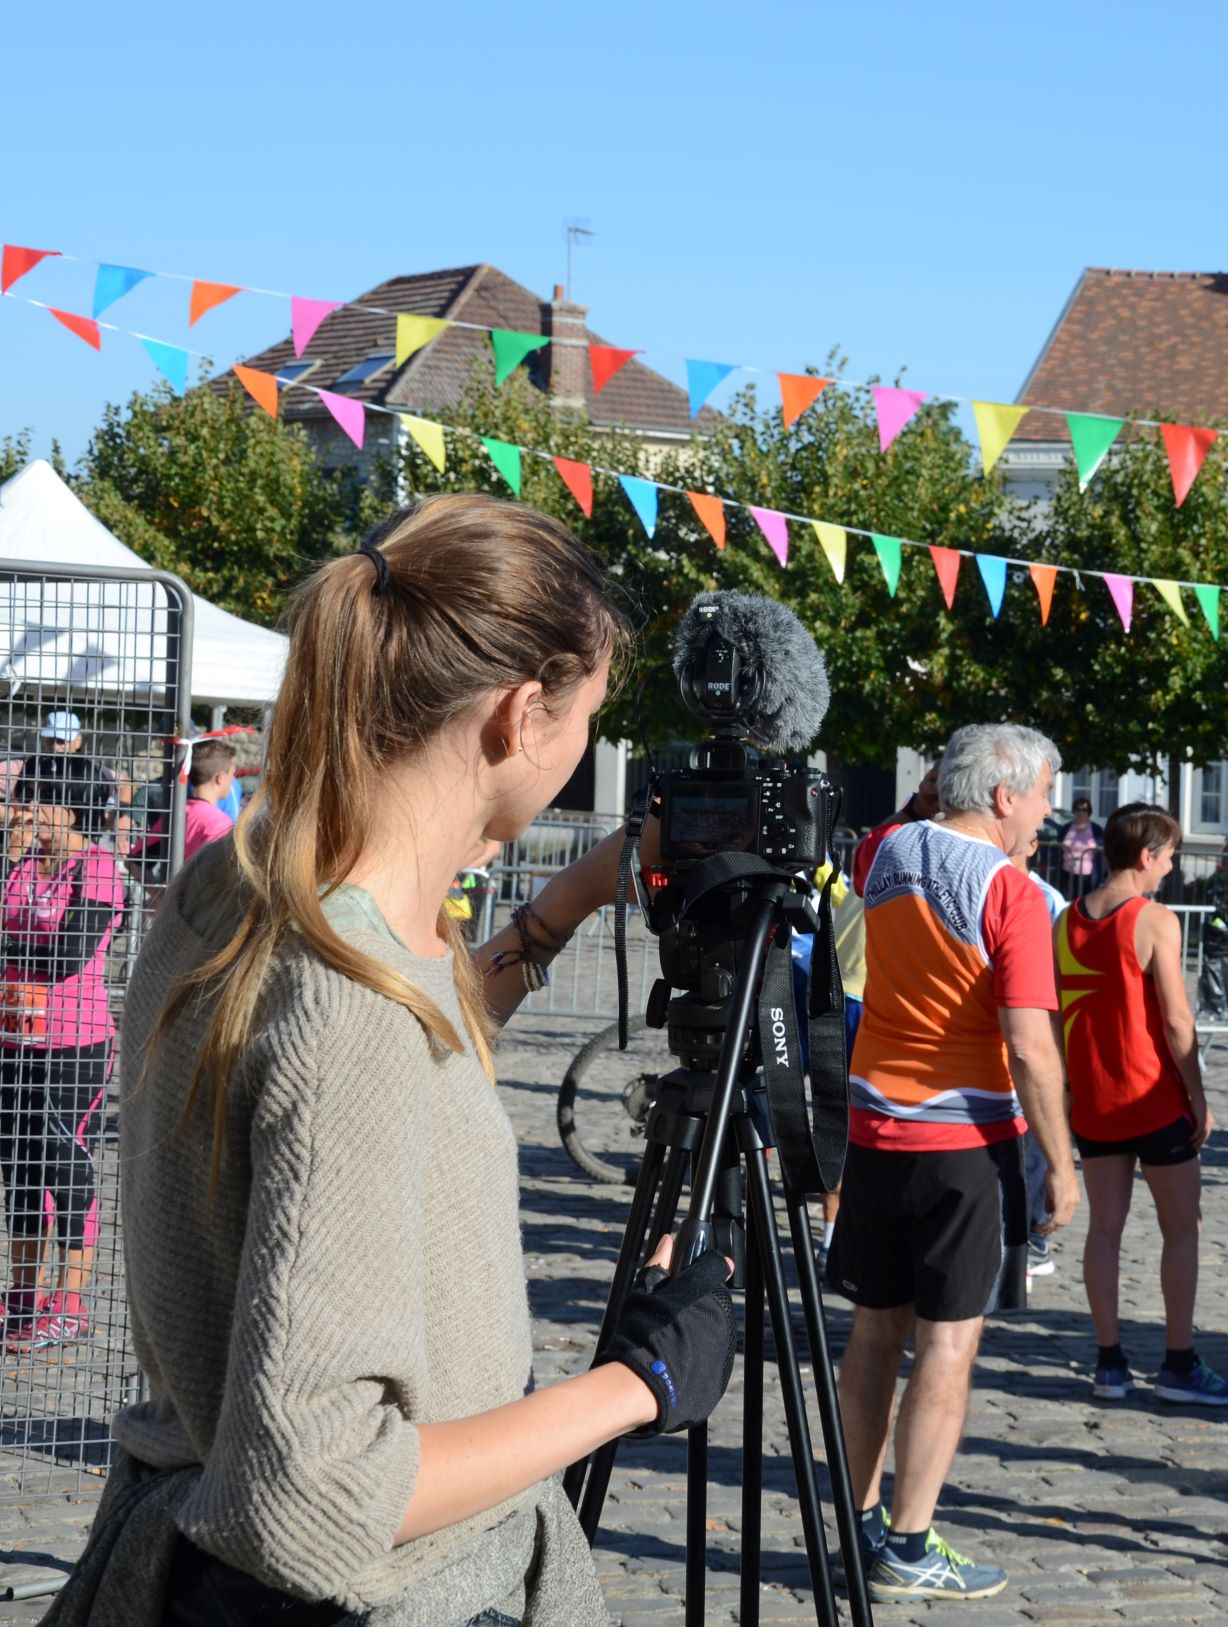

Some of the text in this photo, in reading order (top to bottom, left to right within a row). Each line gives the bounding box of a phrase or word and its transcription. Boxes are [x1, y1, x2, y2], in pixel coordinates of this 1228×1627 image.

[866, 871, 968, 932] THILLAY RUNNING ATHLETIC CLUB
[770, 1007, 790, 1068] SONY
